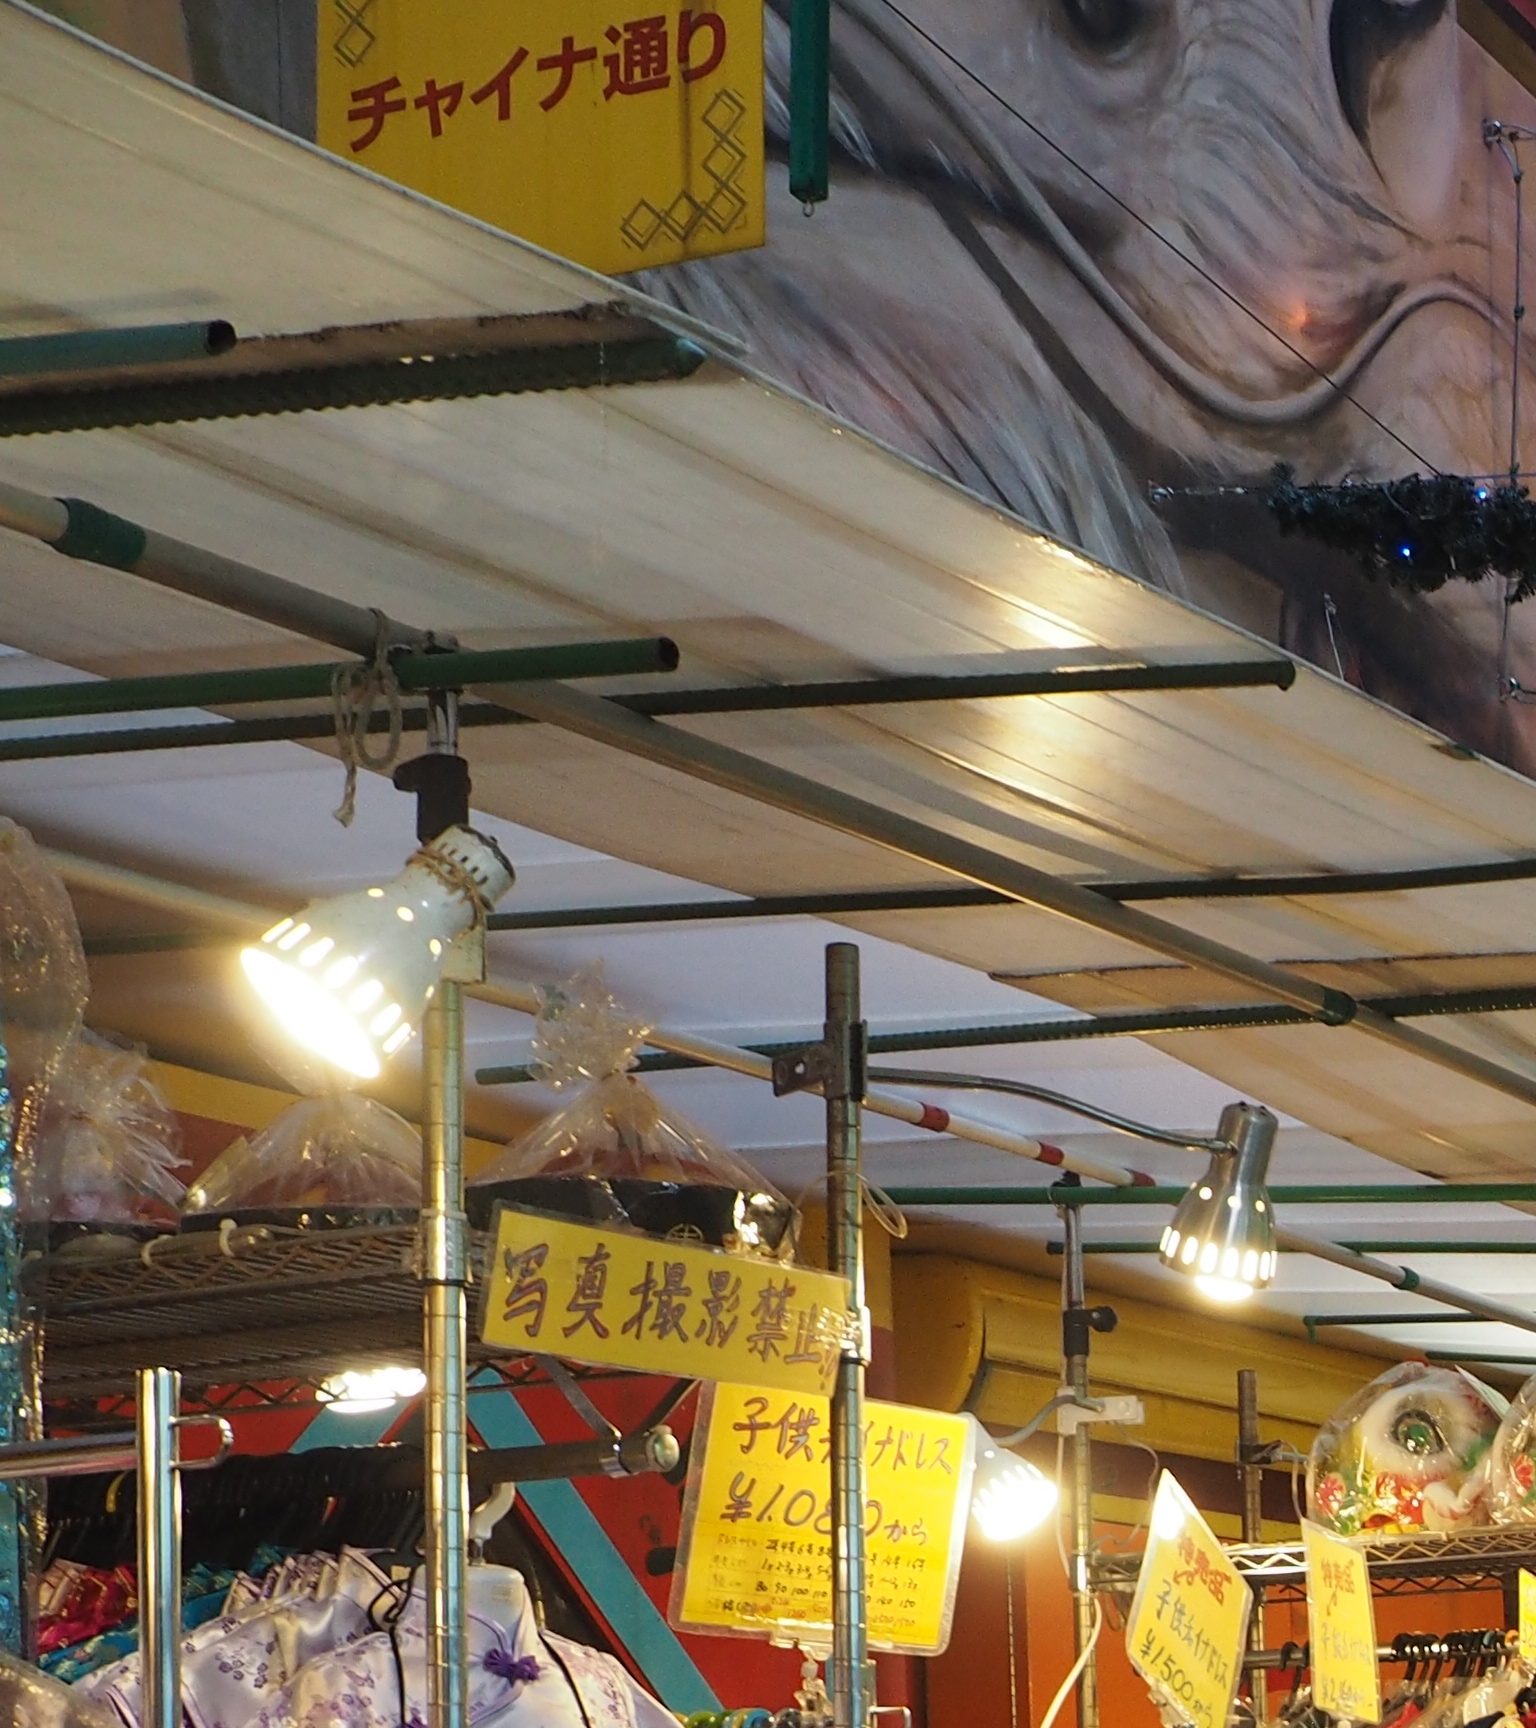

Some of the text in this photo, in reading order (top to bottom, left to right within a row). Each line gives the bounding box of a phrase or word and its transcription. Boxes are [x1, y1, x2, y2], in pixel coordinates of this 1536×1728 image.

[347, 8, 727, 153] チャイナ通り
